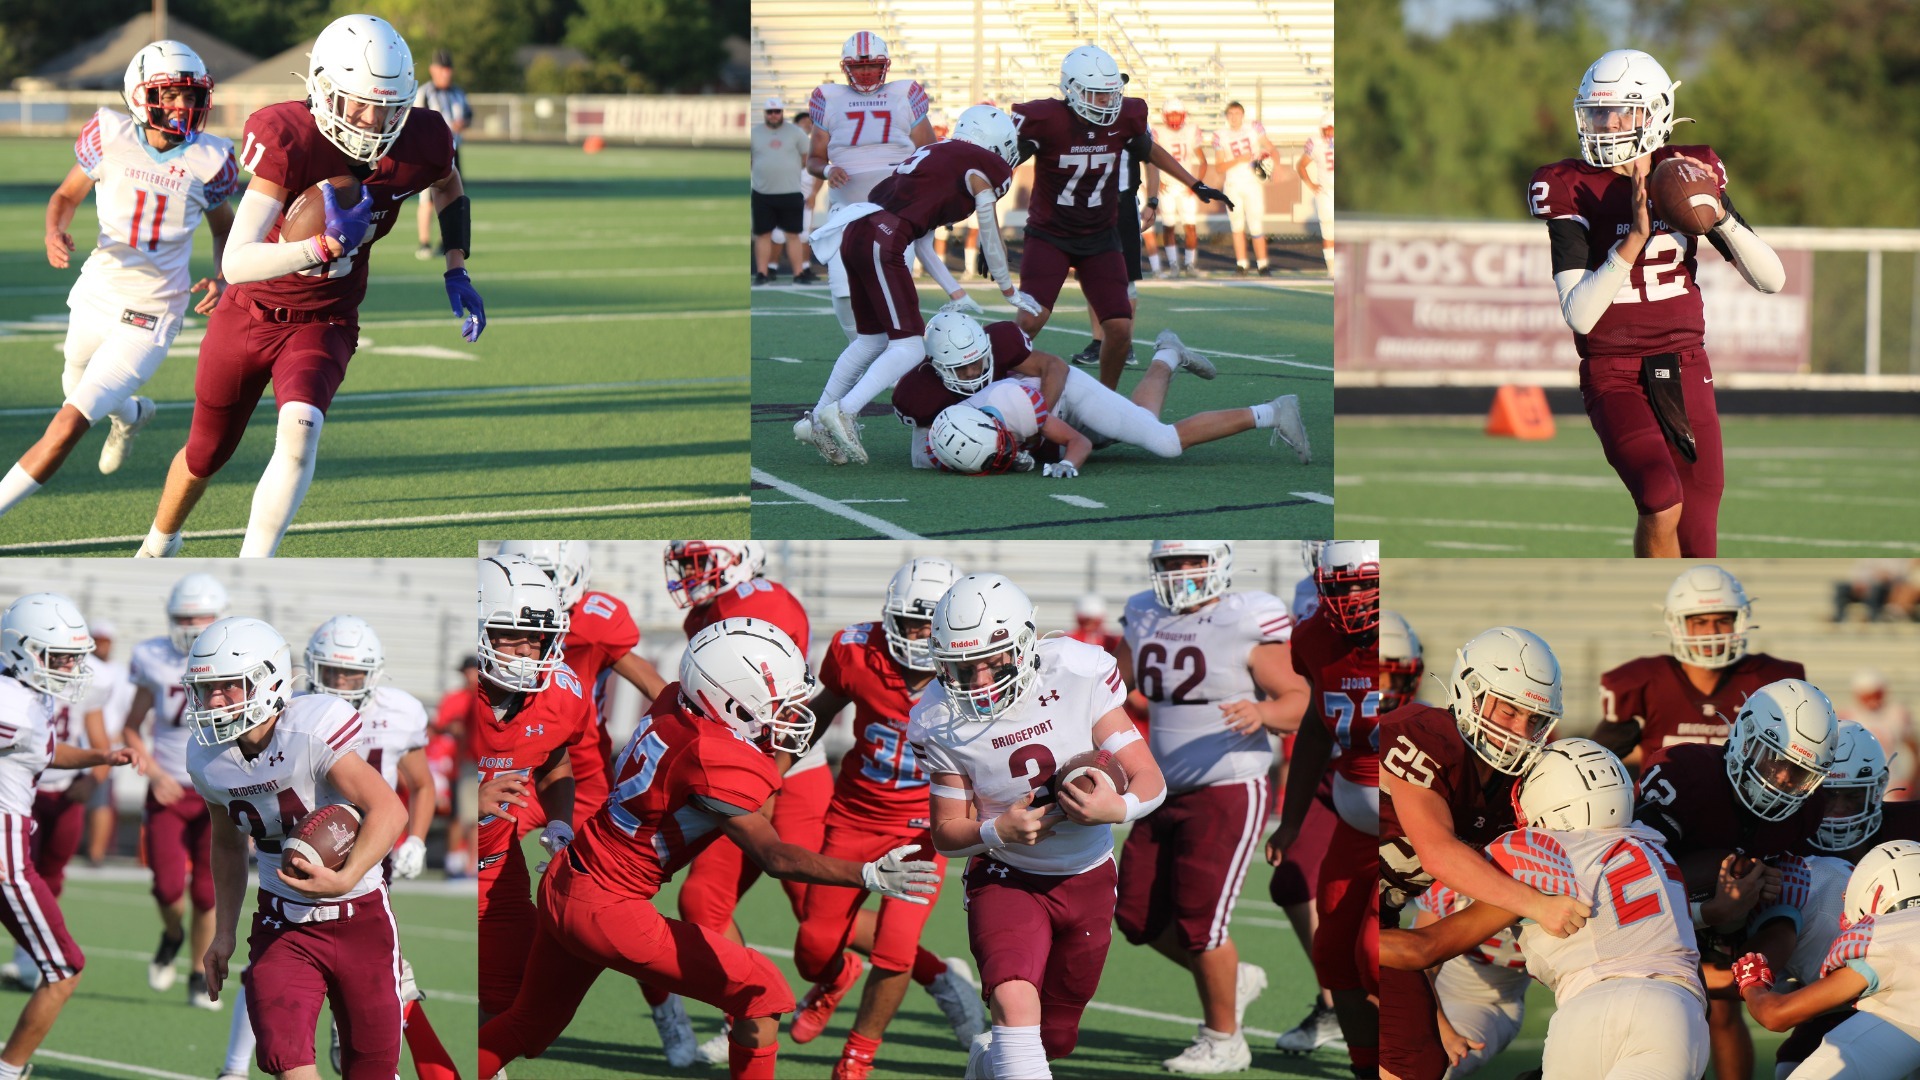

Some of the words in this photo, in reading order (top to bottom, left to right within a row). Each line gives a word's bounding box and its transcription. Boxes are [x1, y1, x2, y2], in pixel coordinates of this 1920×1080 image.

[373, 87, 398, 96] Riddell
[848, 100, 887, 108] CASTLEBERRY
[845, 111, 891, 146] 77
[239, 131, 266, 176] 11
[1070, 144, 1108, 154] BRIDGEPORT
[124, 167, 182, 191] CASTLEBERRY
[1057, 153, 1117, 208] 77
[128, 188, 169, 252] 11
[1367, 240, 1464, 285] DOS
[951, 638, 979, 649] Riddell
[1154, 630, 1197, 643] BRIDGEPORT
[1137, 643, 1208, 706] 62
[1341, 677, 1372, 690] LIONS
[1525, 690, 1550, 704] Riddell
[991, 719, 1054, 750] BRIDGEPORT
[478, 756, 514, 770] IONS
[1383, 735, 1442, 788] 25
[228, 780, 280, 798] BRIDGEPORT
[228, 786, 310, 854] 24
